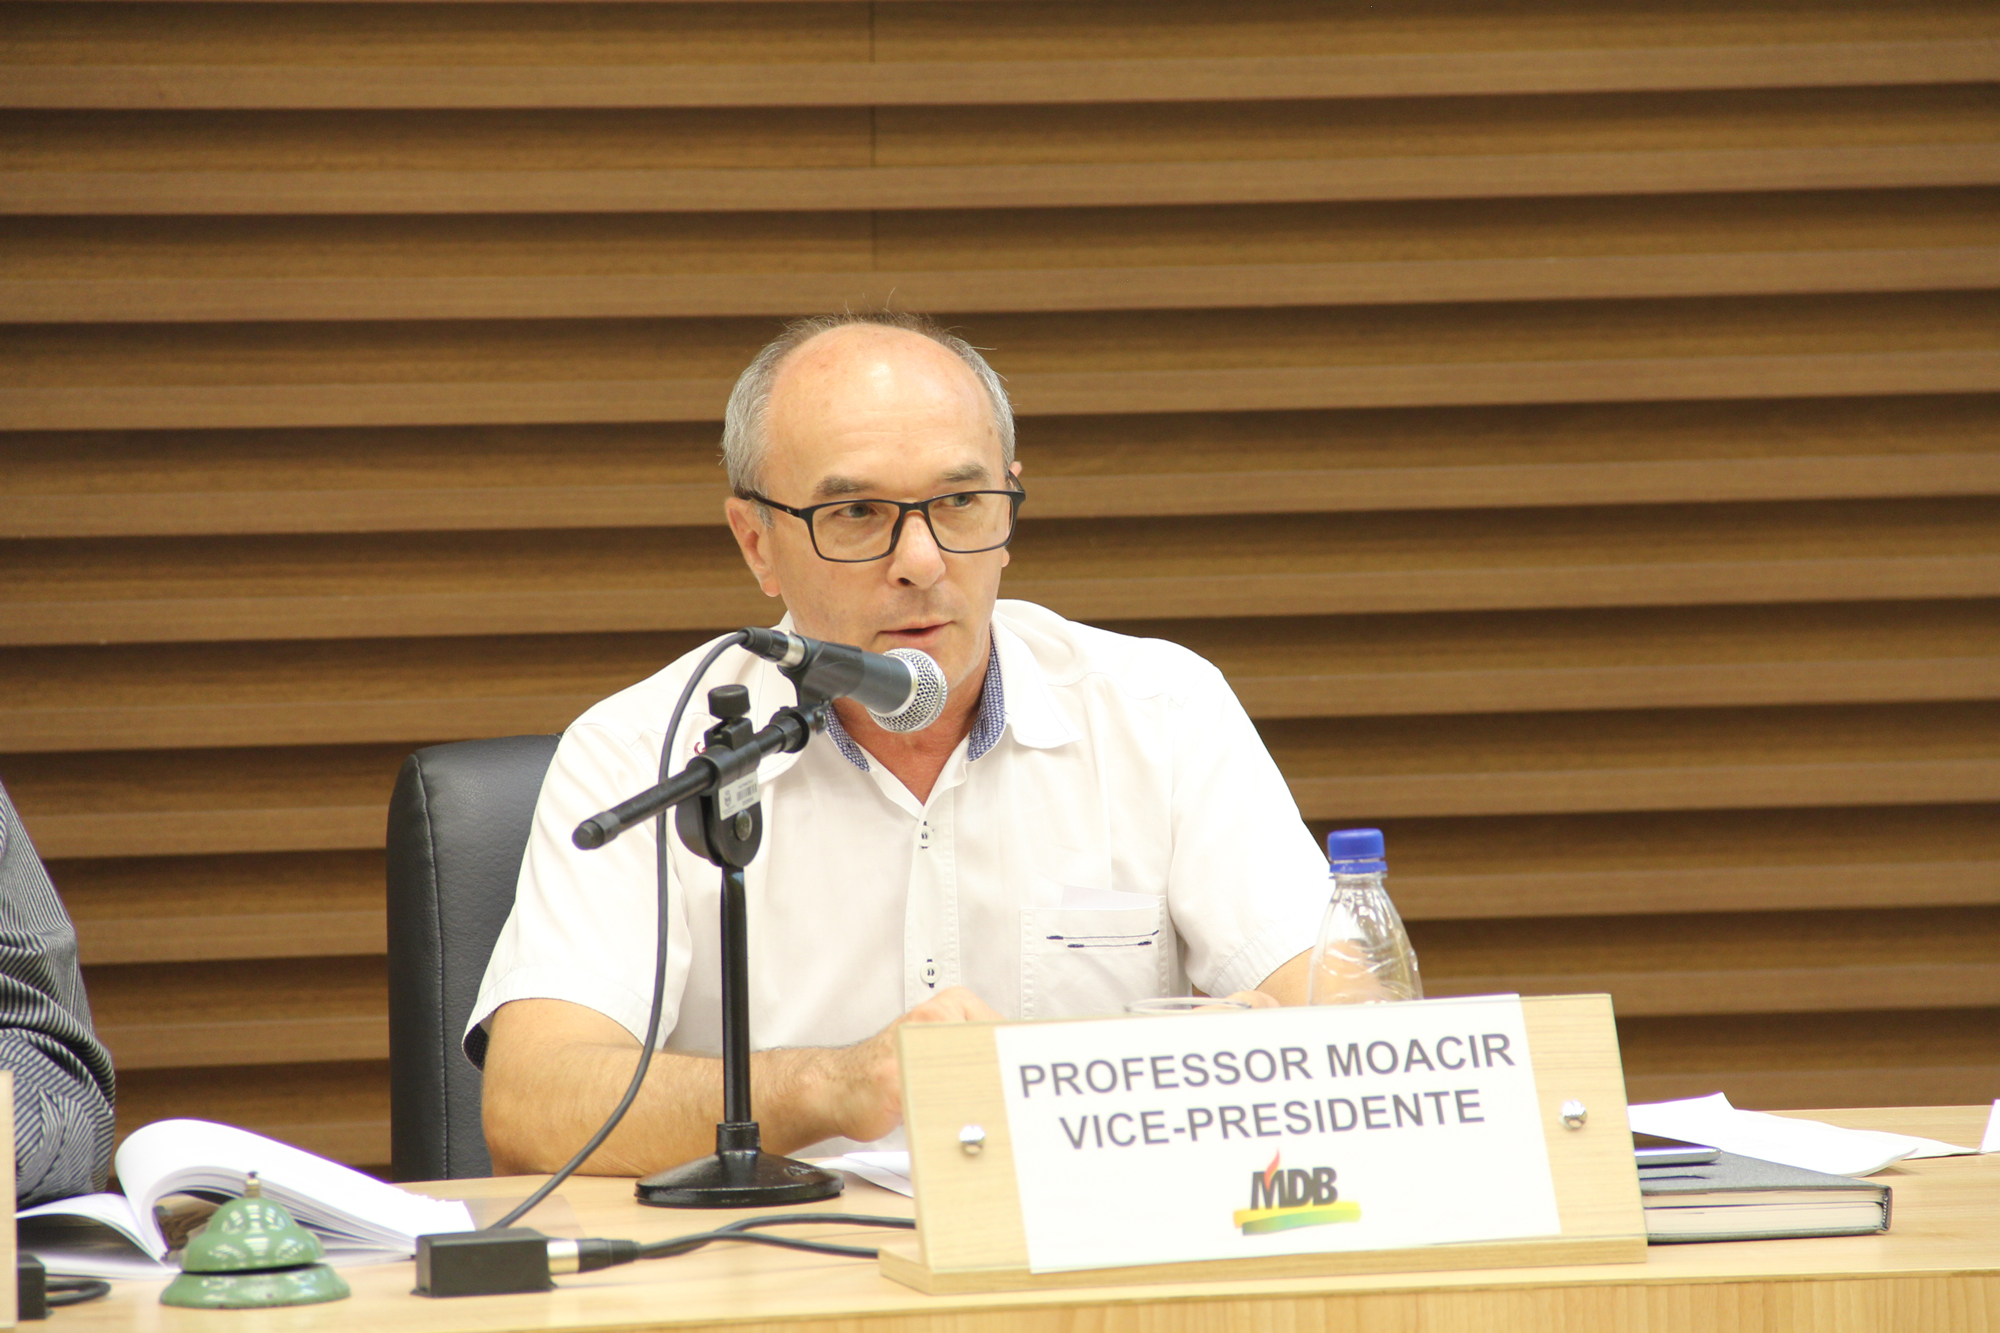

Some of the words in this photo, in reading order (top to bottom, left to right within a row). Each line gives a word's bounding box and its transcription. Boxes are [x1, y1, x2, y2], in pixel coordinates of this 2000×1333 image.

[1019, 1046, 1313, 1099] PROFESSOR
[1326, 1033, 1516, 1078] MOACIR
[1058, 1088, 1485, 1150] VICE-PRESIDENTE
[1249, 1166, 1339, 1211] MDB
